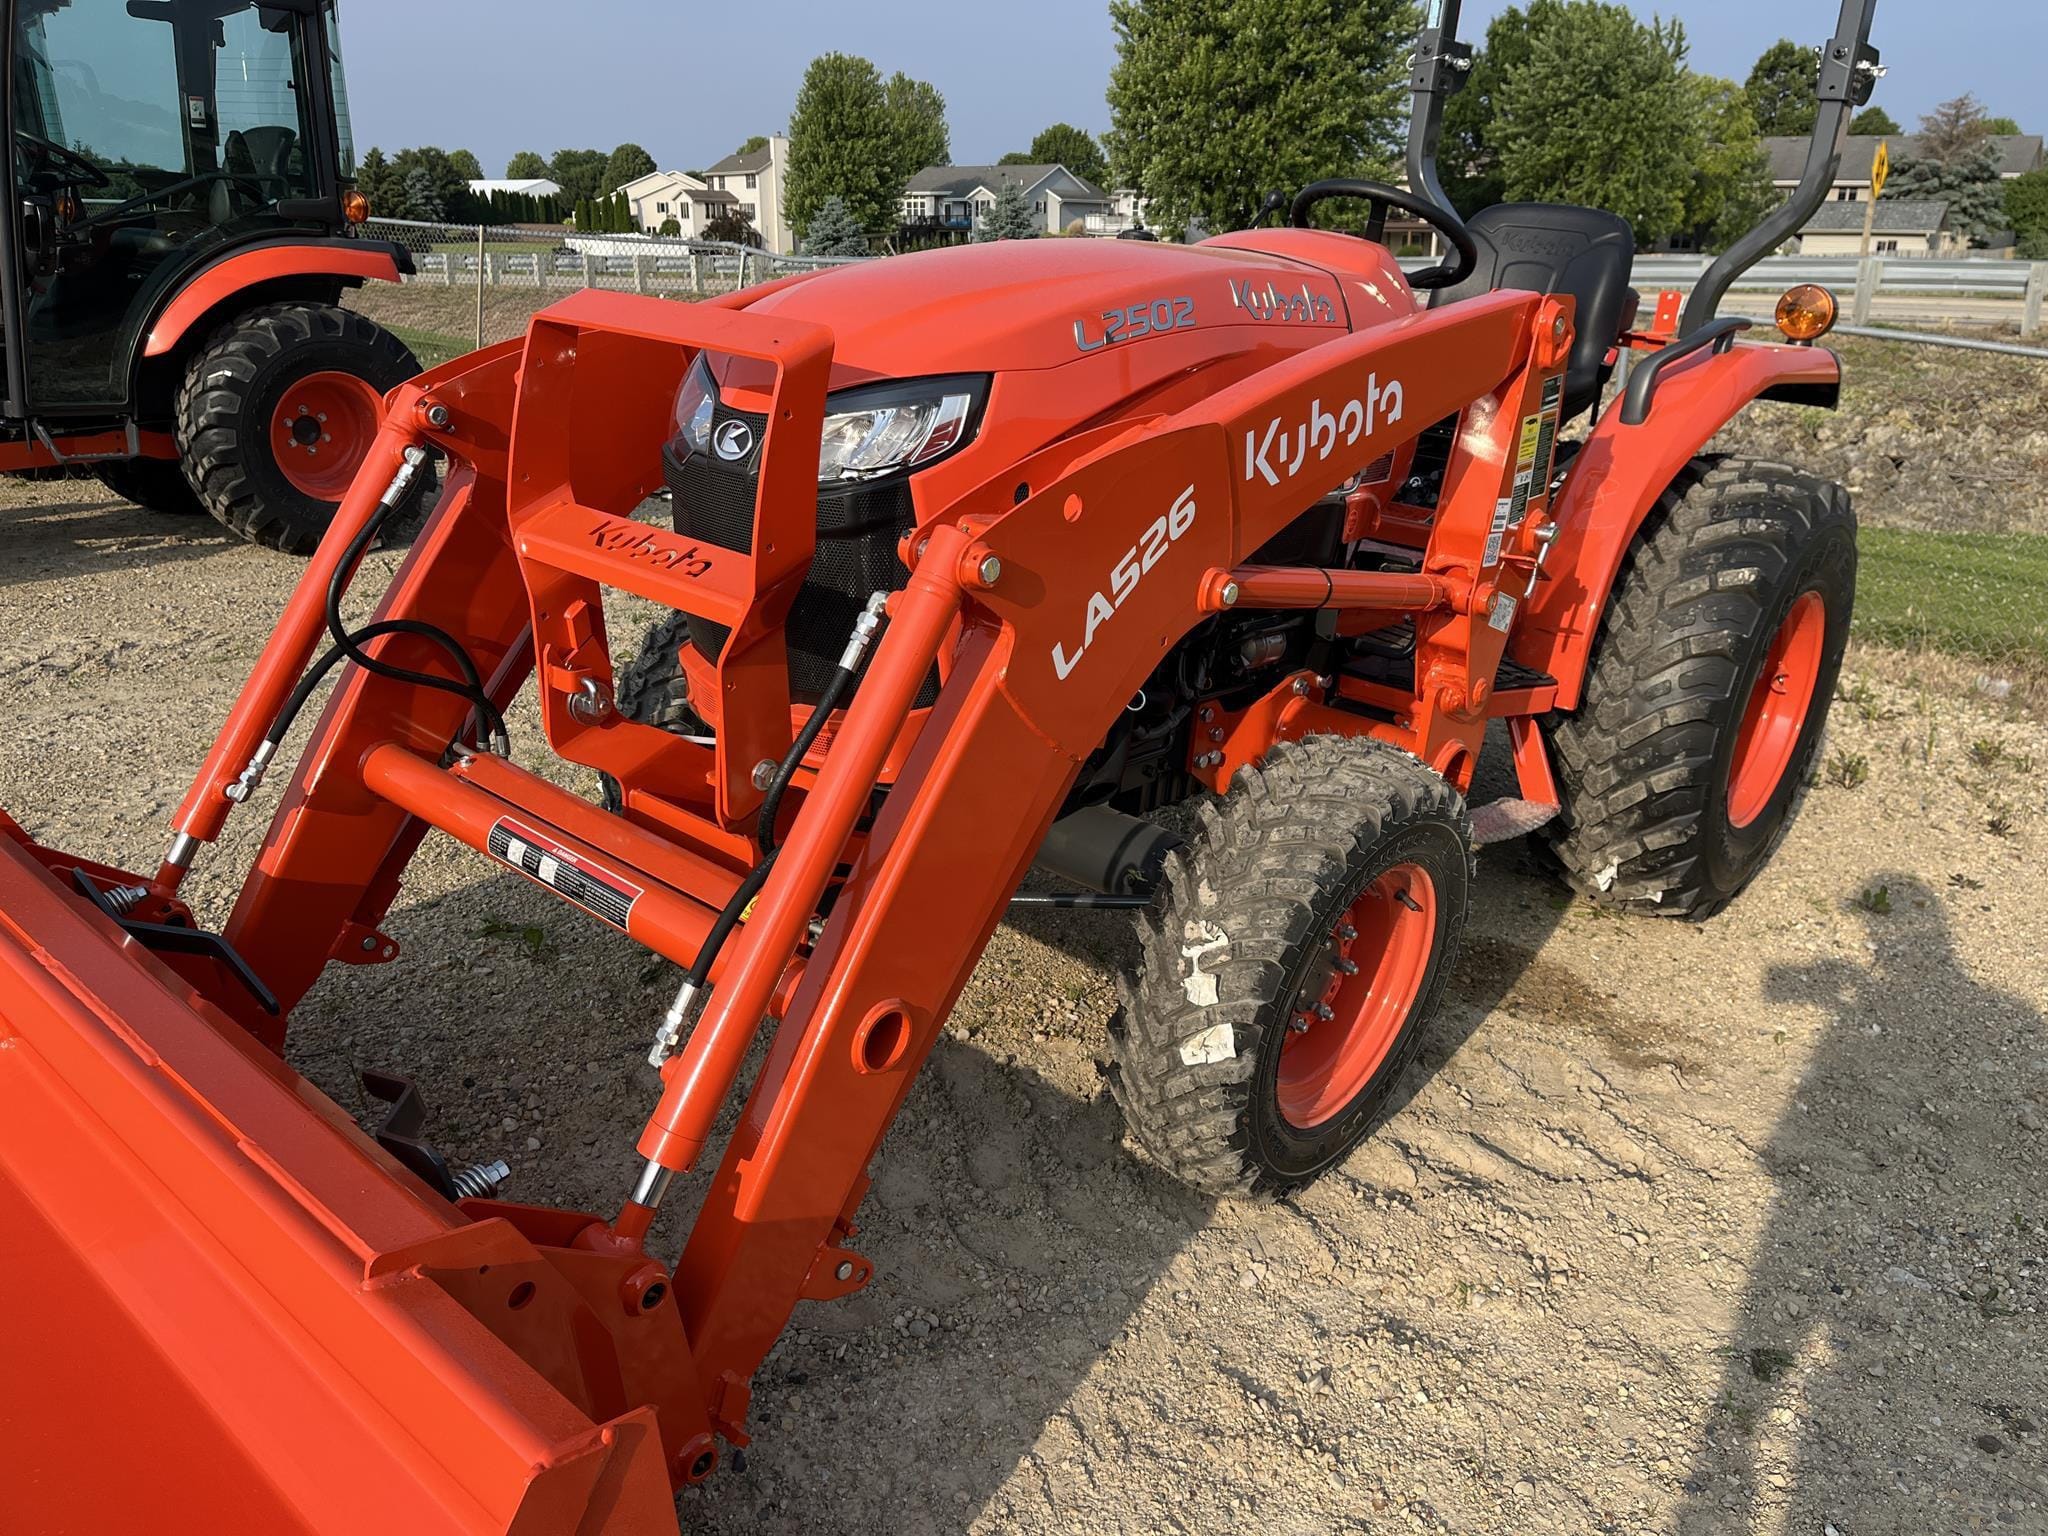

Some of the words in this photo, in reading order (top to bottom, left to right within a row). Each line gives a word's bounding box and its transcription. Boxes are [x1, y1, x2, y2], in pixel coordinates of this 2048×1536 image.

[1074, 296, 1196, 352] L2502
[1229, 279, 1336, 322] Kubota
[1246, 372, 1403, 486] Kubota
[589, 520, 713, 578] Kubota
